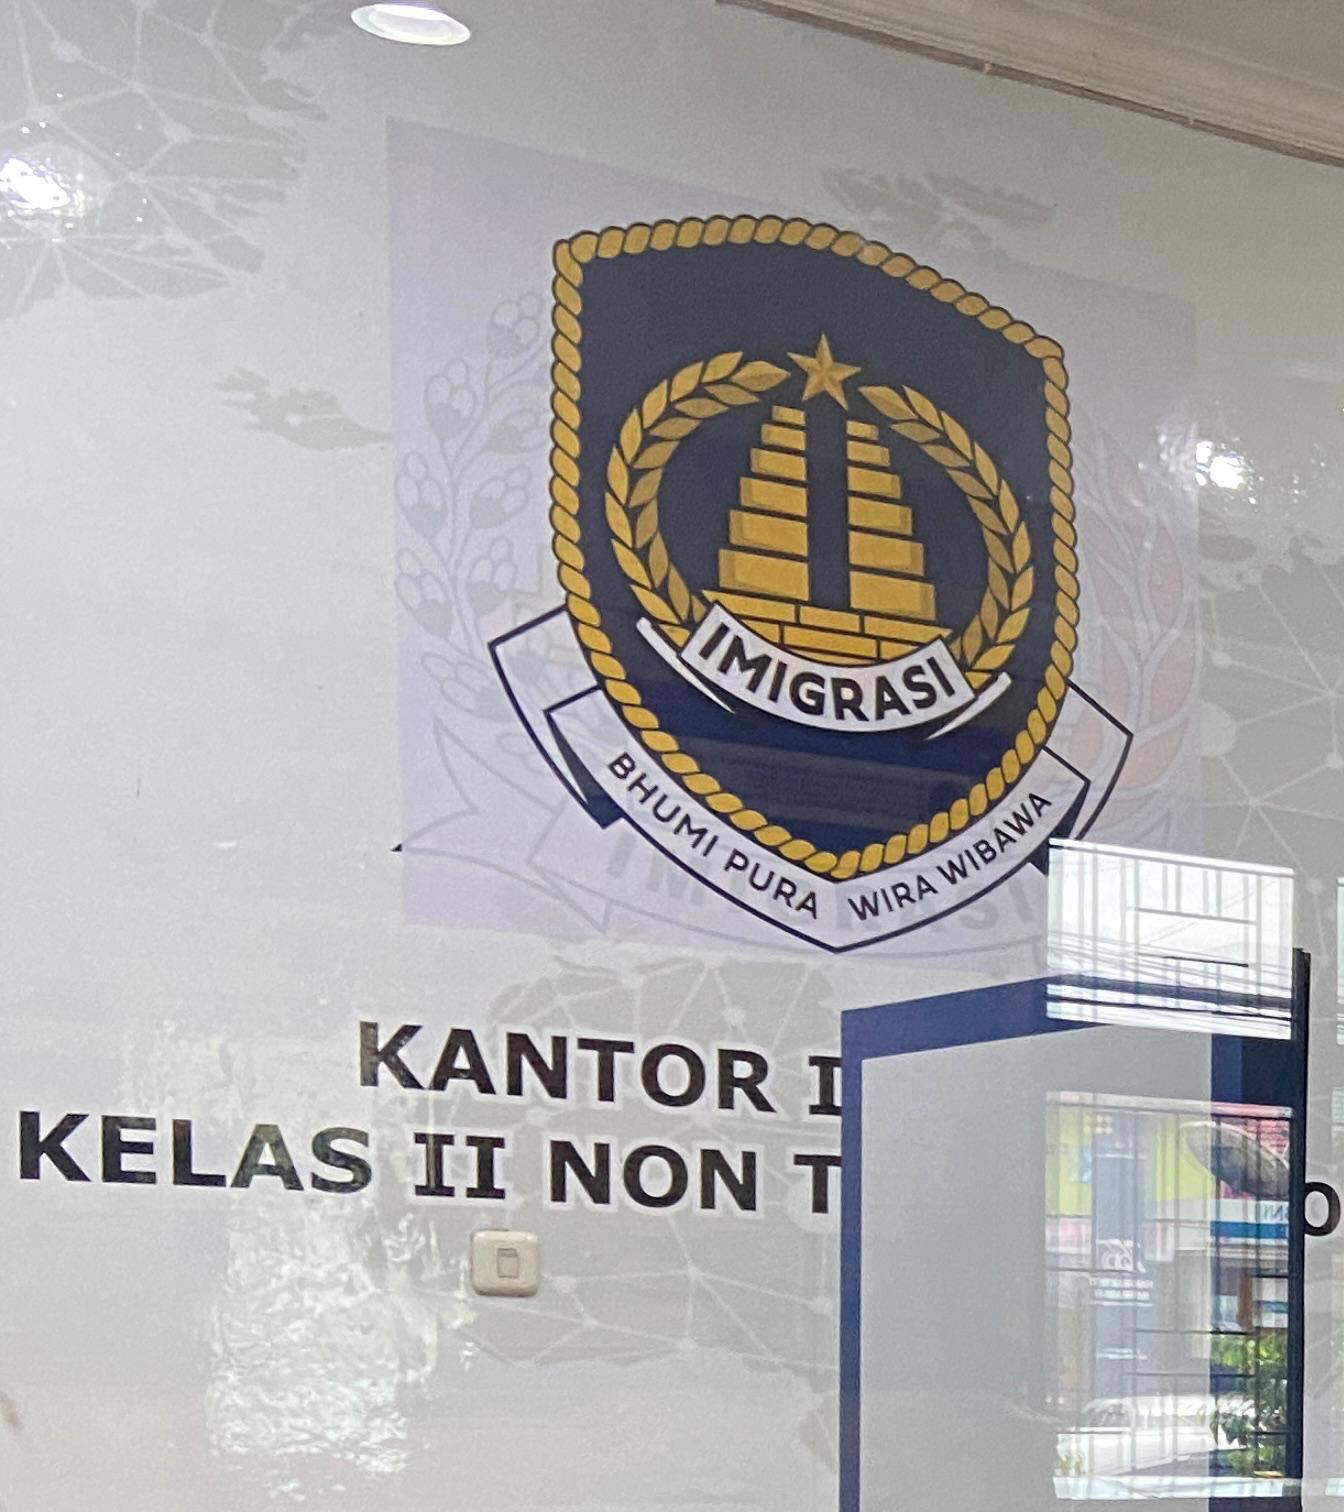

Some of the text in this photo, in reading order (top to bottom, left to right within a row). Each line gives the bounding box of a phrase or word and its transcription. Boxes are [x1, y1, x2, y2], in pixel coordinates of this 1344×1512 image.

[700, 623, 955, 722] IMIGRASI
[607, 751, 1051, 920] BHUMI PURA WIRA WIBAWA
[359, 1020, 776, 1113] KANTOR
[18, 1110, 371, 1193] KELAS
[414, 1133, 505, 1198] II
[550, 1140, 757, 1211] NON
